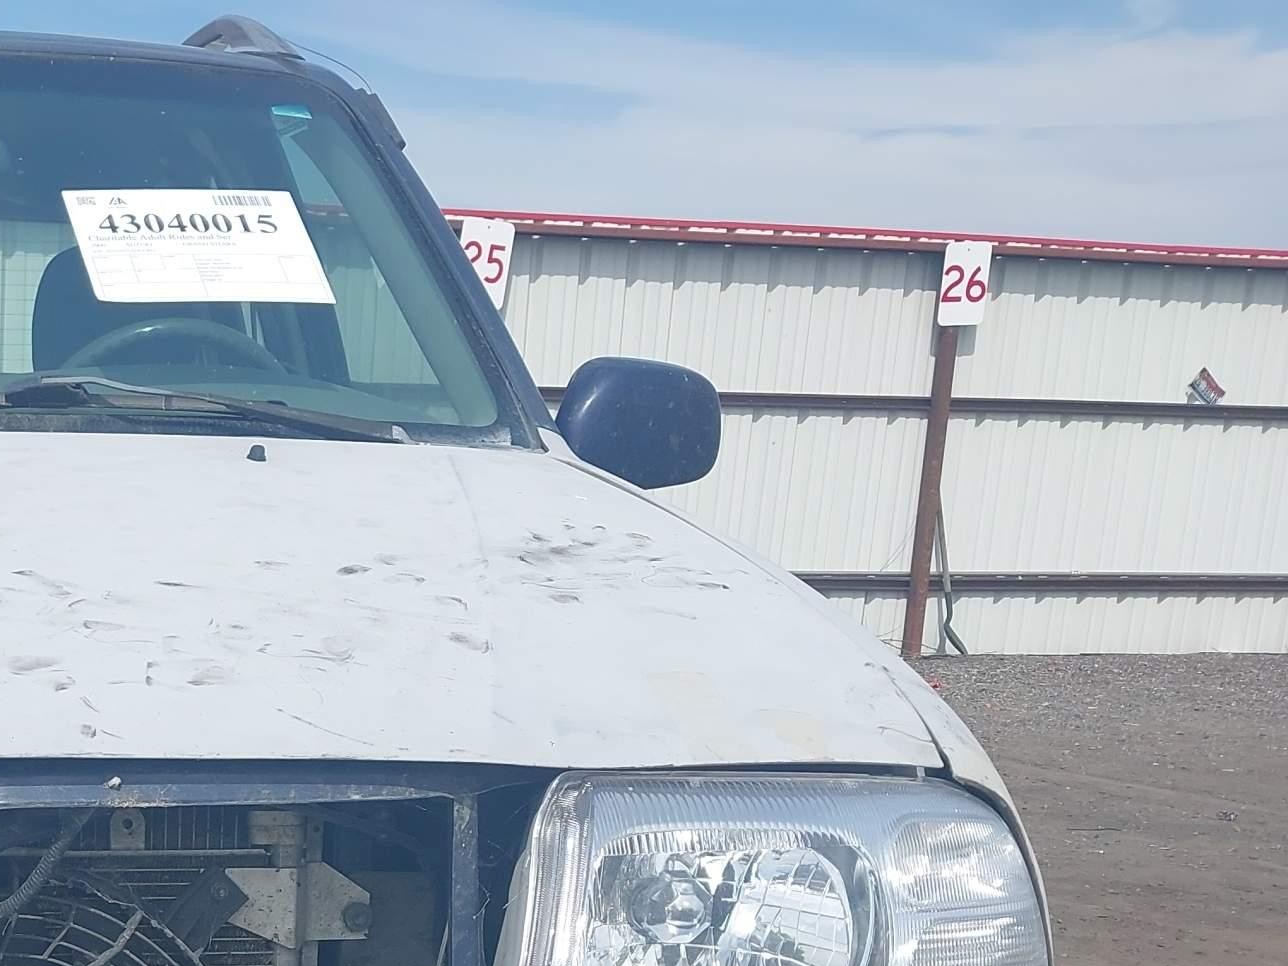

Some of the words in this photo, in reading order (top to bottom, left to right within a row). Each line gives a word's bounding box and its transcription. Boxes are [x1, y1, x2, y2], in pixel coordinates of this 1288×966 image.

[98, 213, 279, 234] 43040015
[463, 240, 506, 284] 25
[941, 264, 986, 303] 26
